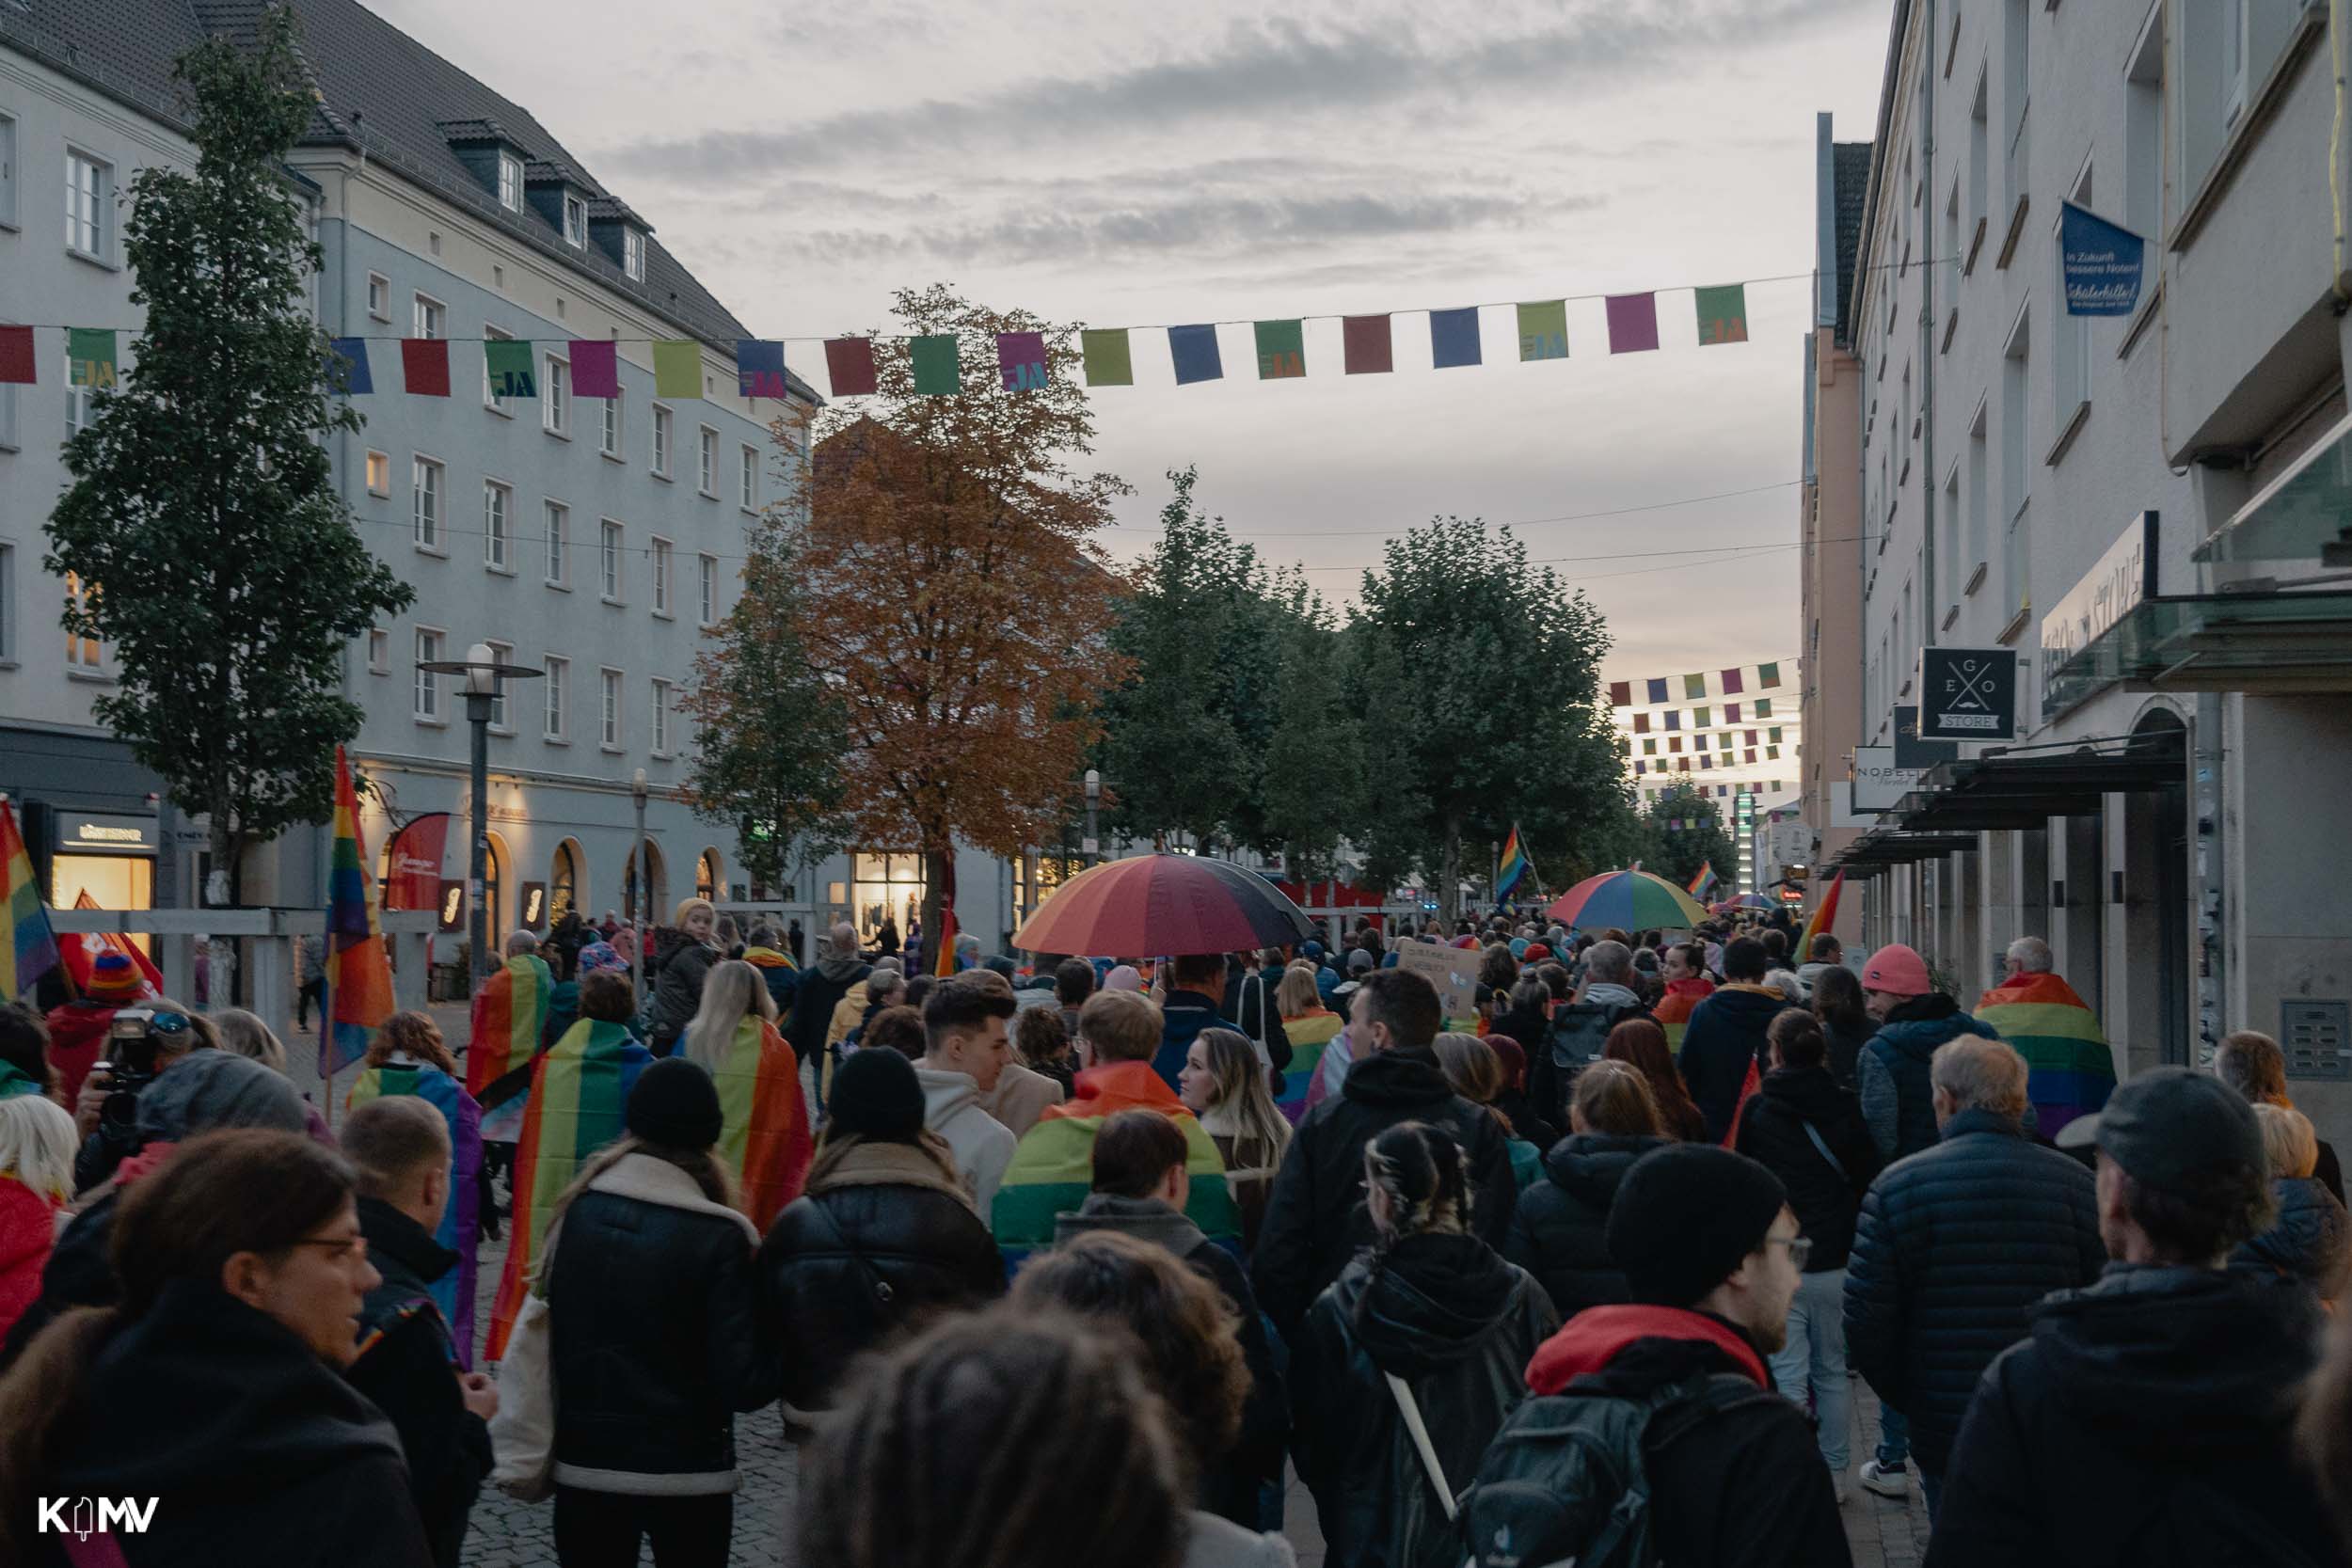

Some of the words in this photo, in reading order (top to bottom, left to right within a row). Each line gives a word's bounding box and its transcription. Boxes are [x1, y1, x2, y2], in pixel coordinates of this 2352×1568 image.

[2077, 252, 2115, 263] Zukunft
[2066, 263, 2105, 274] bessere
[2106, 263, 2140, 274] Noten!
[1009, 361, 1048, 391] JA
[1946, 714, 1991, 728] STORE
